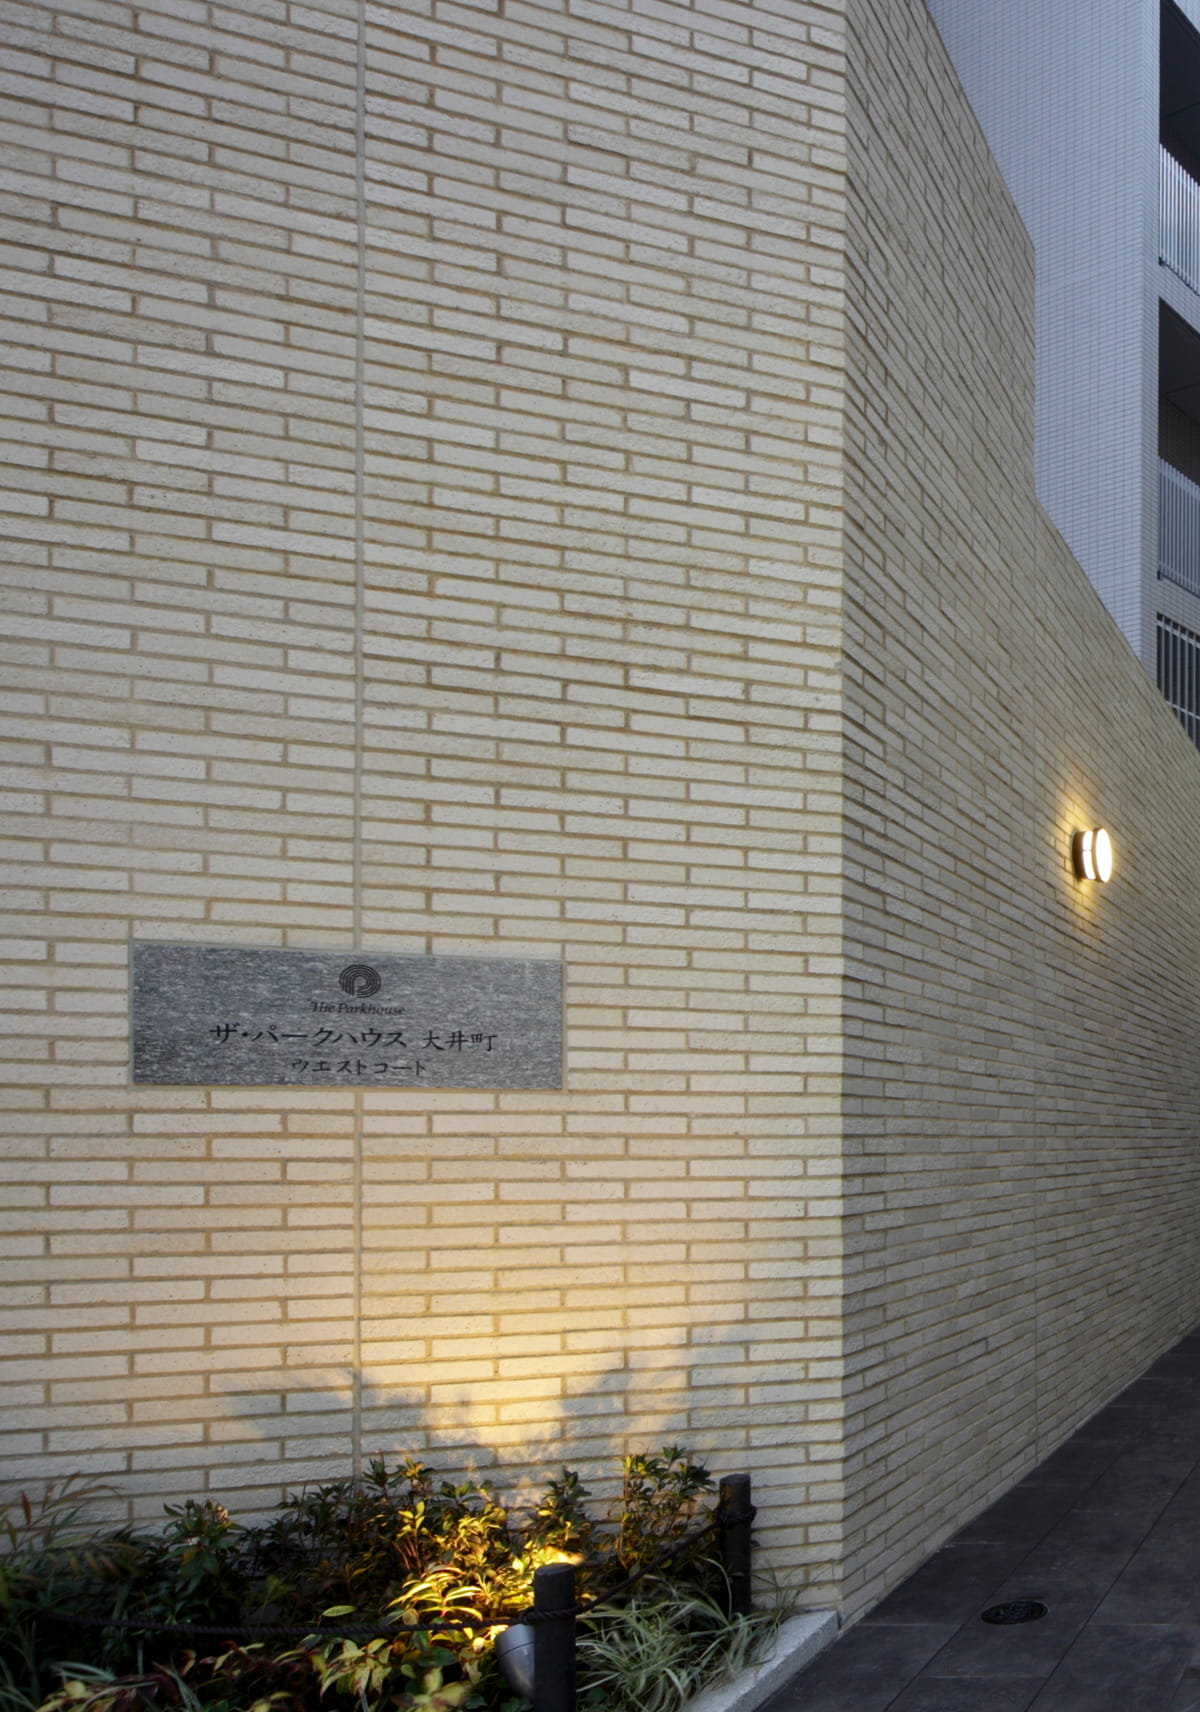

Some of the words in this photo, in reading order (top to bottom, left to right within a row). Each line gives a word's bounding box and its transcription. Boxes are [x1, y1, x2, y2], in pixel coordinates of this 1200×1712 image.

[311, 1001, 335, 1014] The
[338, 1003, 405, 1016] Parkhouse
[209, 1023, 407, 1047] ザ・パークハウス
[421, 1030, 498, 1052] 大井町
[291, 1059, 426, 1076] ウエストコート
